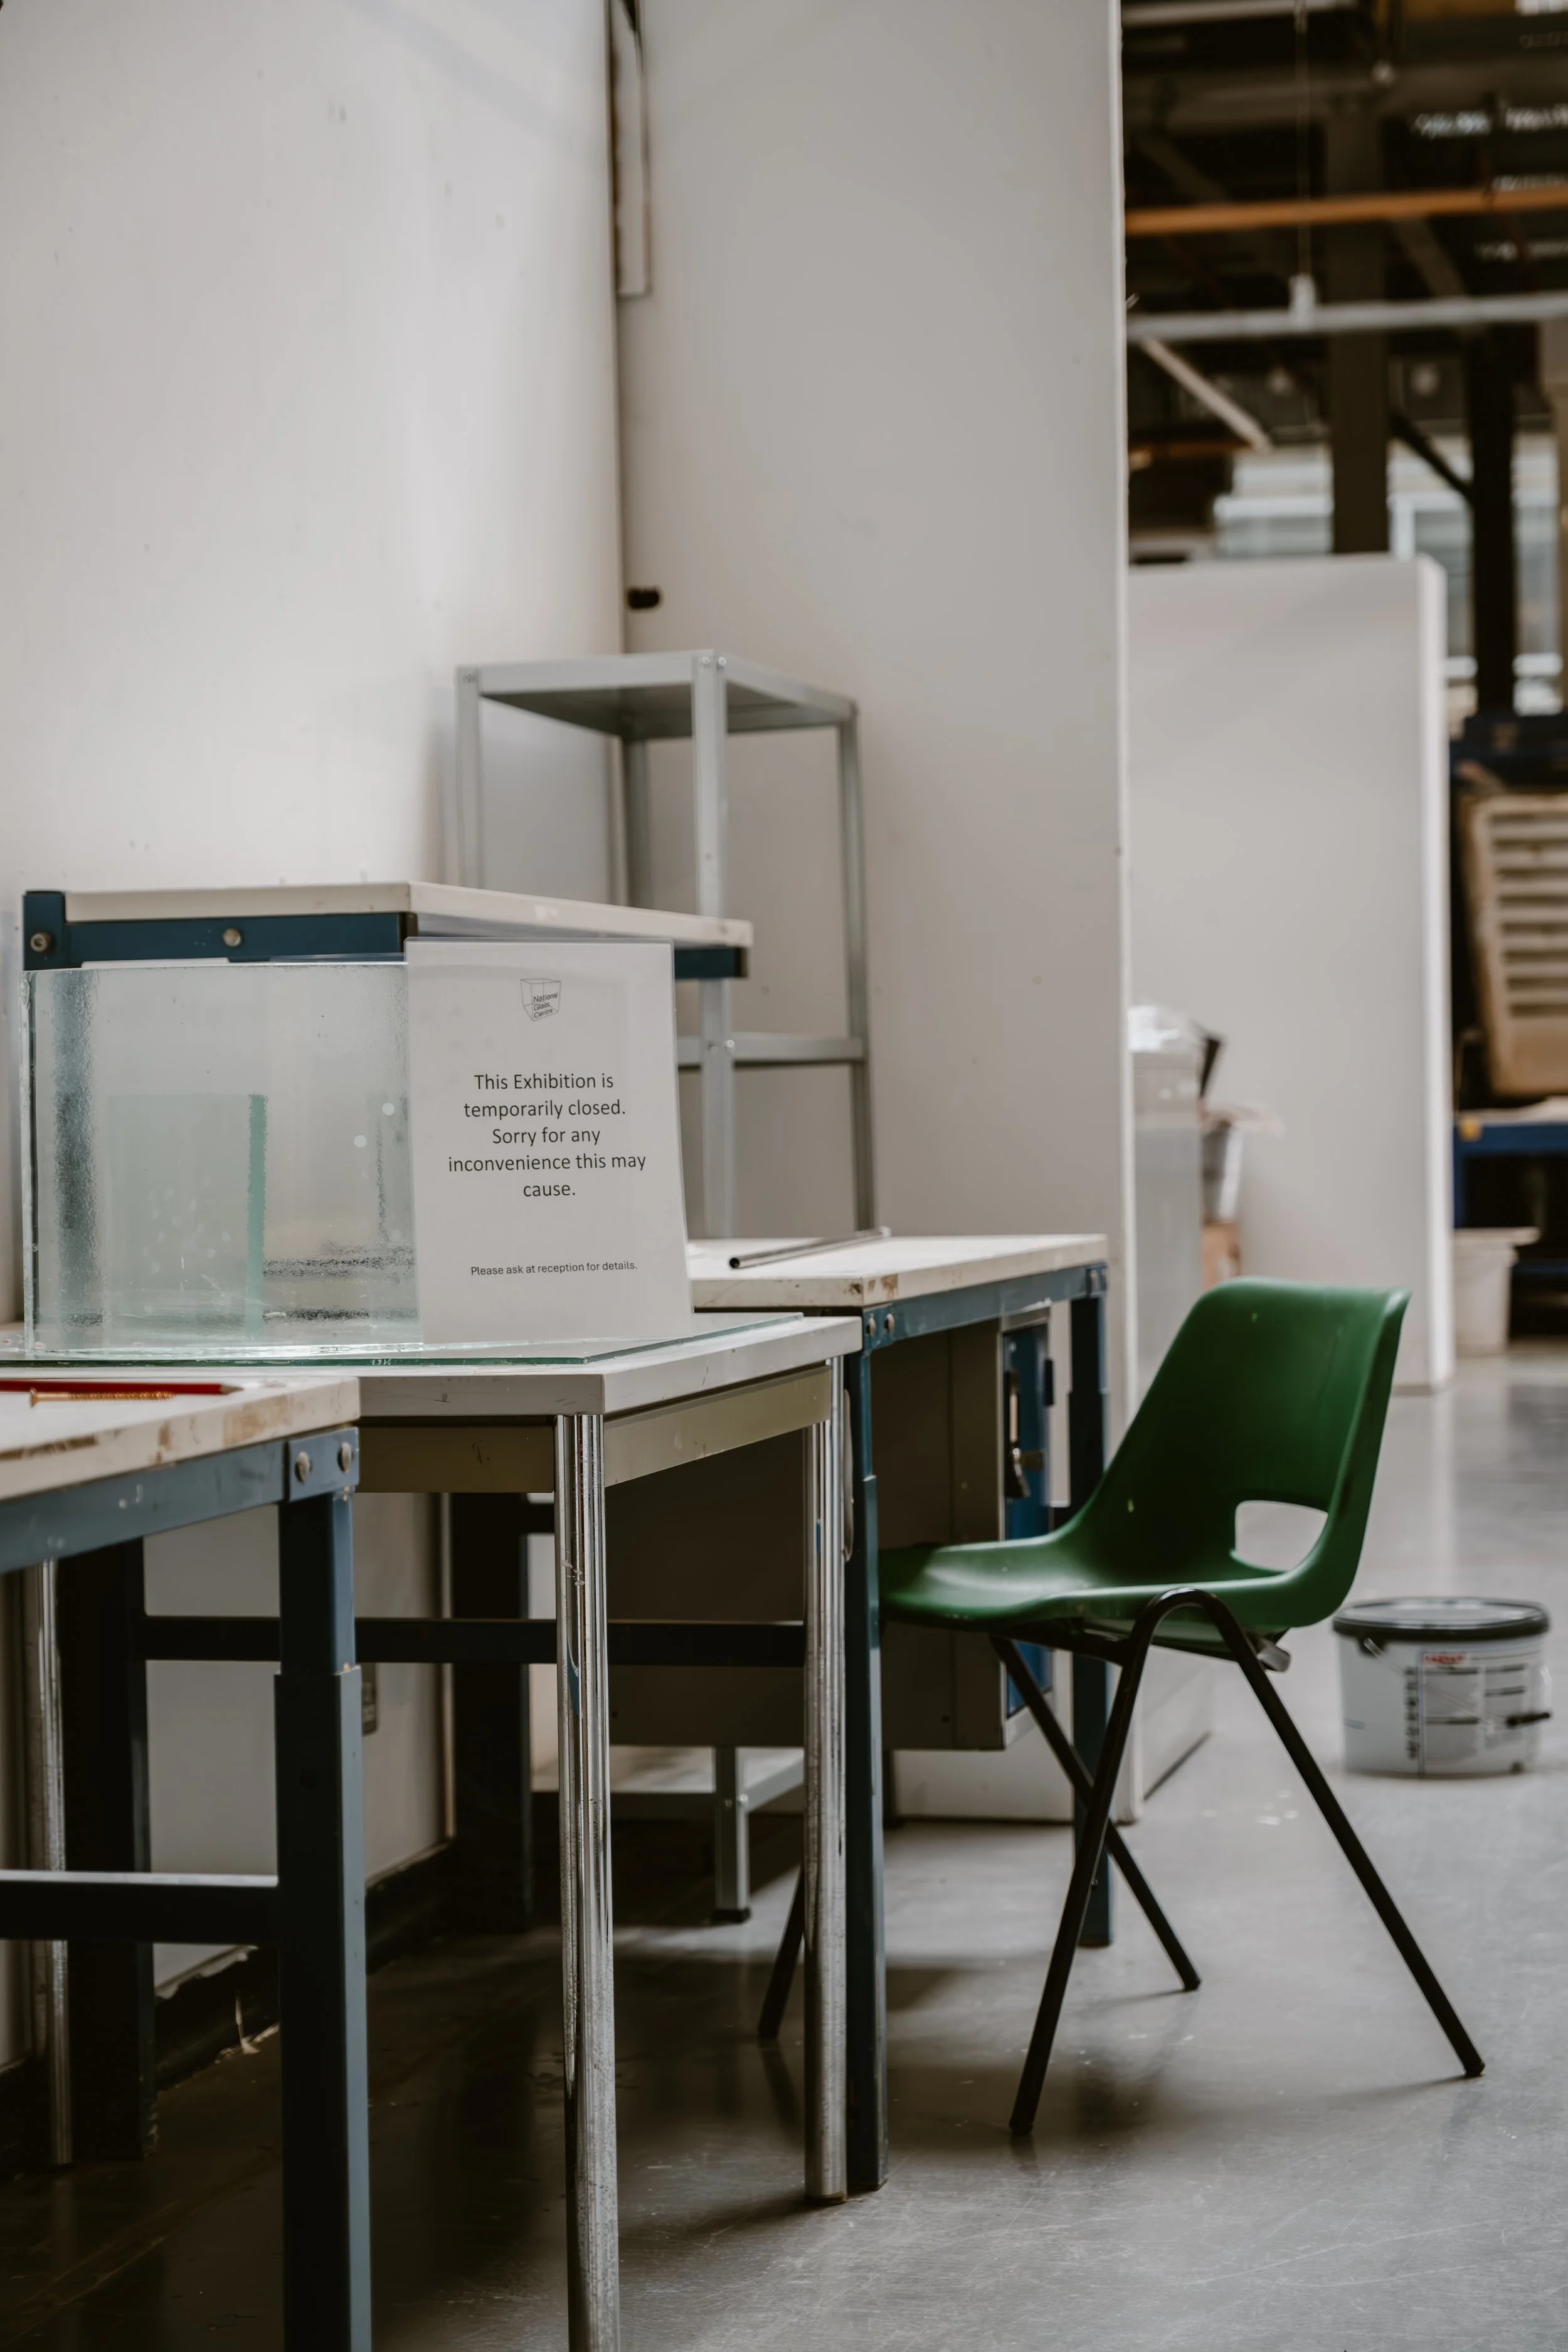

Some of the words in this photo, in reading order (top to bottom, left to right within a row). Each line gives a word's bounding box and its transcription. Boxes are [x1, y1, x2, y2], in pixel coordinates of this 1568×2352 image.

[533, 992, 558, 1002] National
[533, 1002, 550, 1011] Glass
[534, 1009, 553, 1019] Centre
[474, 1074, 508, 1090] This
[514, 1073, 596, 1089] Exhibition
[602, 1073, 614, 1088] is
[464, 1100, 563, 1121] temporarily
[568, 1099, 625, 1116] closed.
[492, 1128, 537, 1147] Sorry
[542, 1127, 566, 1143] for
[571, 1130, 601, 1146] any
[448, 1155, 571, 1172] inconvenience
[575, 1153, 607, 1168] this
[612, 1156, 646, 1171] may
[523, 1184, 576, 1197] cause.
[471, 1266, 504, 1276] Please
[506, 1265, 523, 1274] ask
[526, 1265, 536, 1274] at
[538, 1263, 585, 1274] reception
[586, 1262, 600, 1271] for
[602, 1261, 638, 1271] details.
